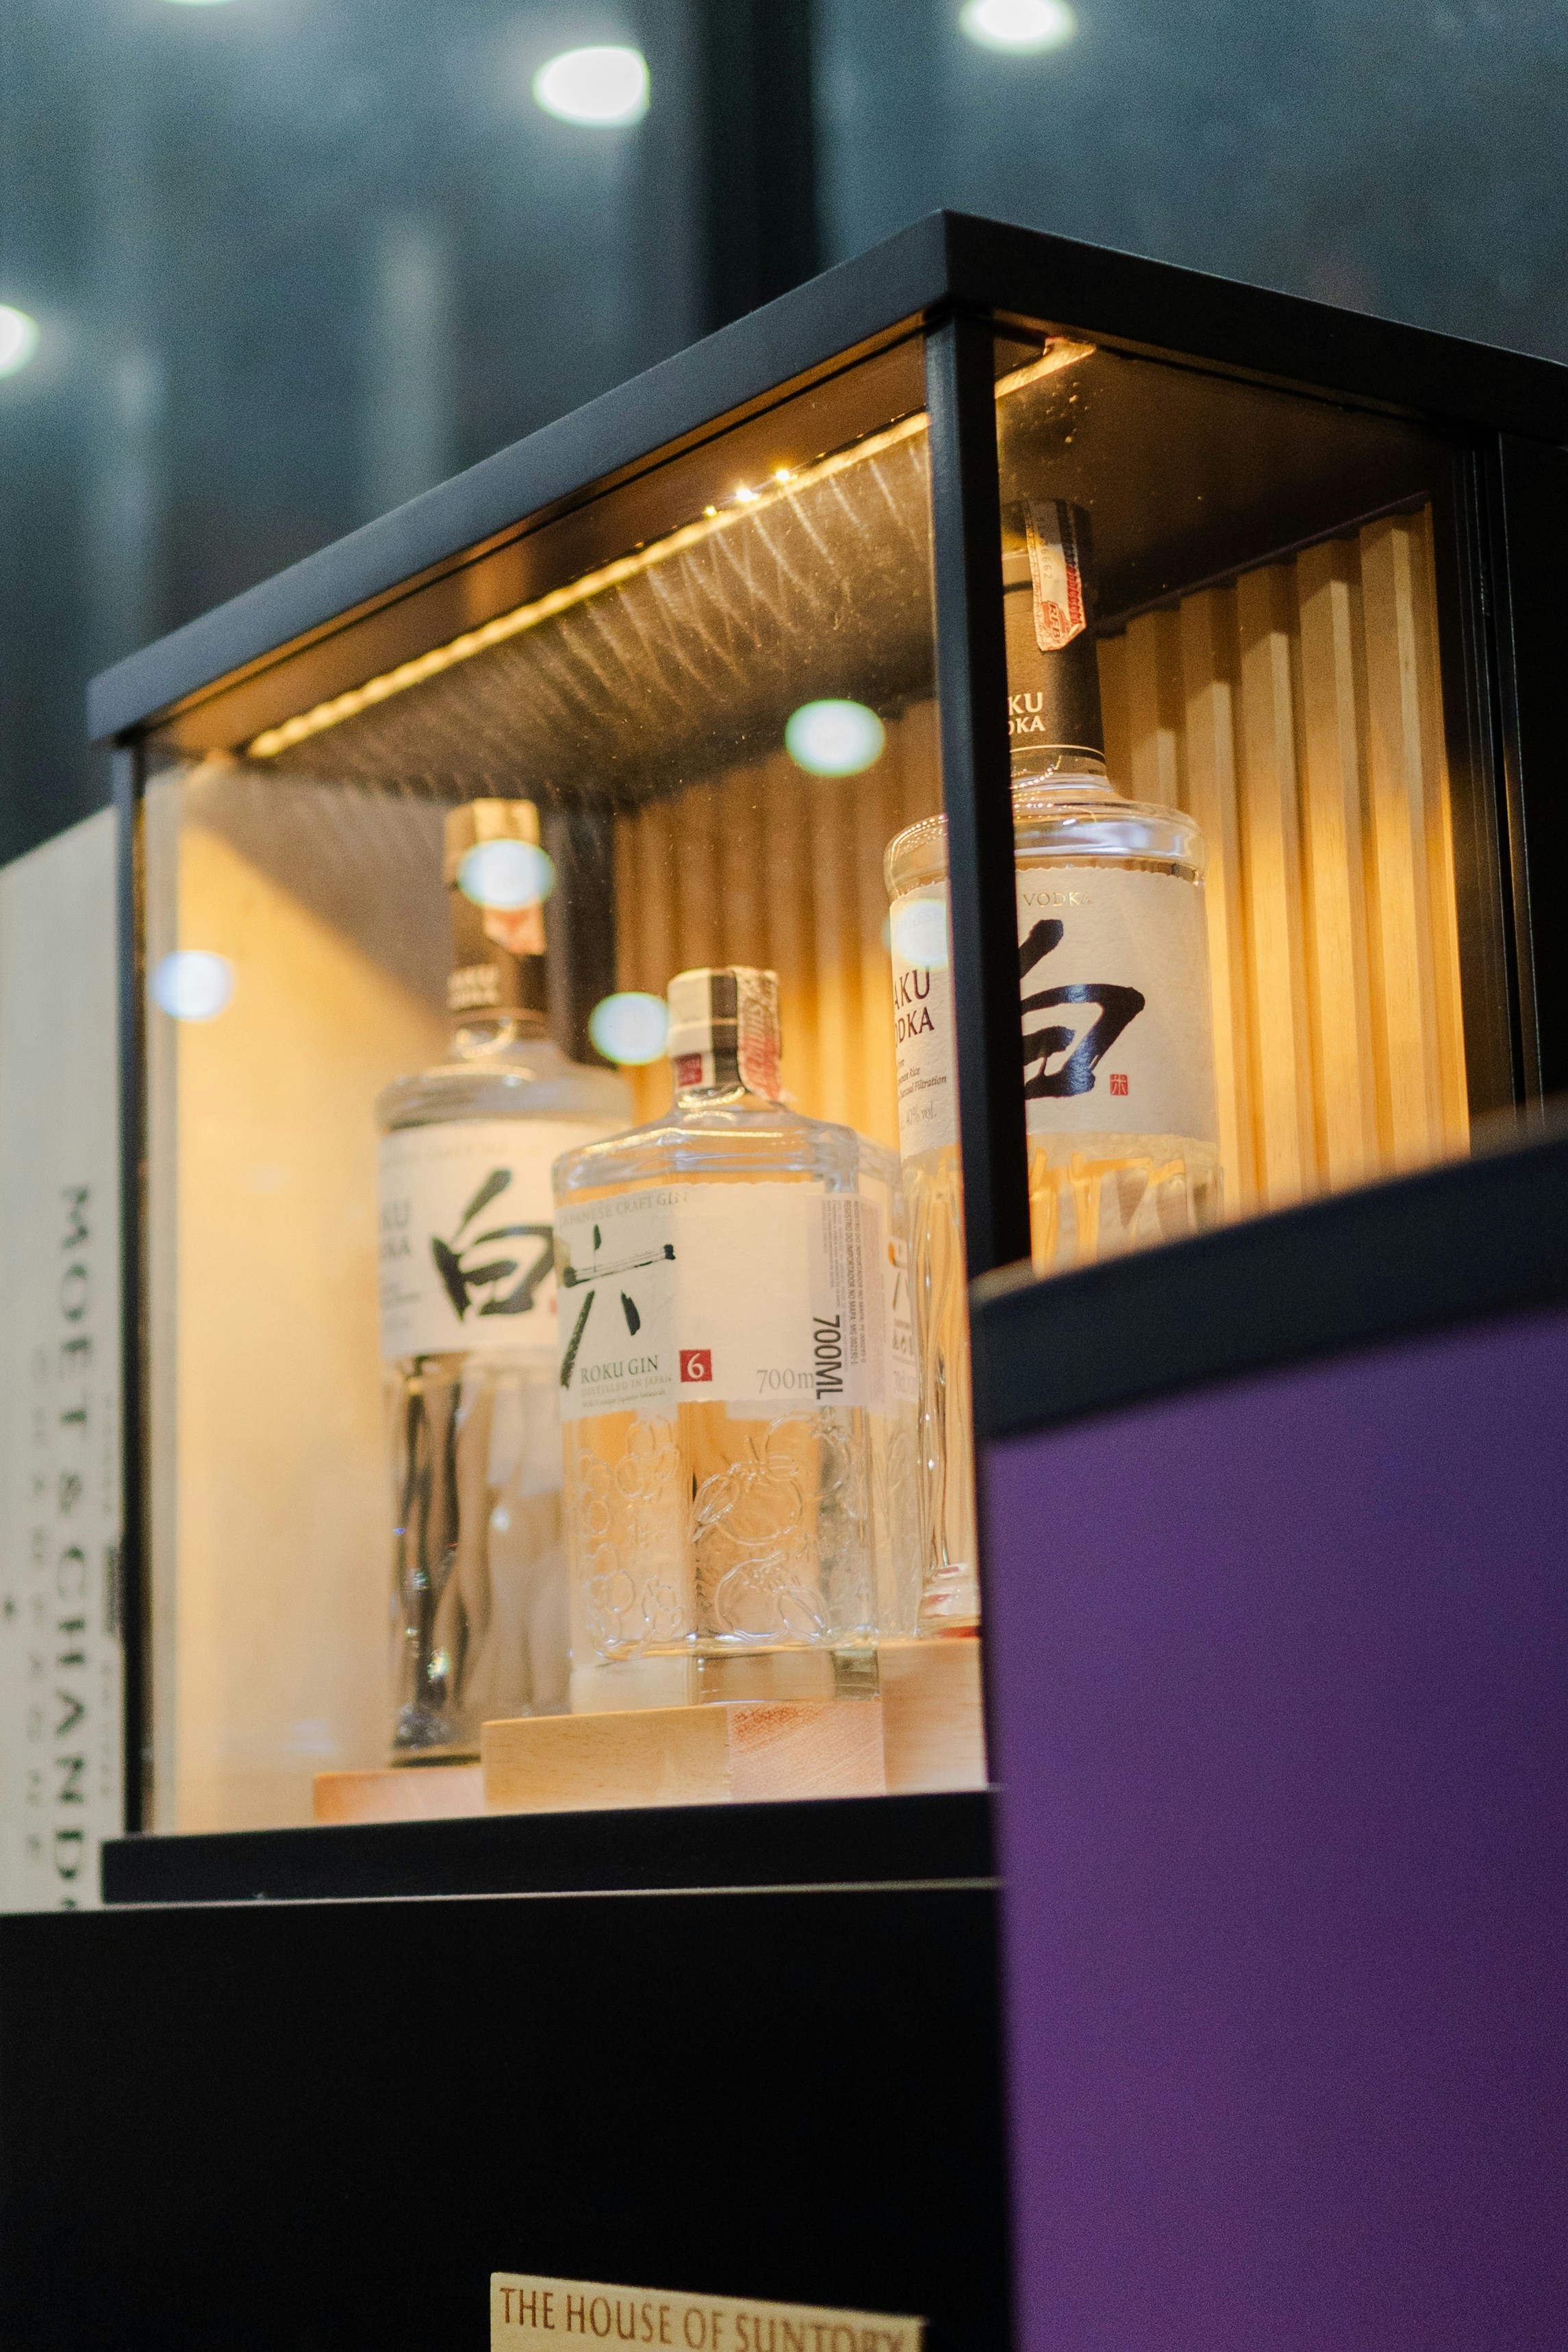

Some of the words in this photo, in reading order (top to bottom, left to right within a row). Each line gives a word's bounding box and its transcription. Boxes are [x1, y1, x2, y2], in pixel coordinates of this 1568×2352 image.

[1022, 892, 1093, 907] VODKA
[914, 1075, 947, 1091] Filtration
[617, 1196, 653, 1215] CRAFT
[657, 1191, 688, 1205] GIN
[579, 1361, 624, 1384] ROKU
[628, 1355, 659, 1375] GIN
[687, 1352, 705, 1379] 6
[812, 1315, 844, 1400] 700ML
[499, 2287, 555, 2329] THE
[566, 2294, 672, 2344] HOUSE
[684, 2306, 724, 2351] OF
